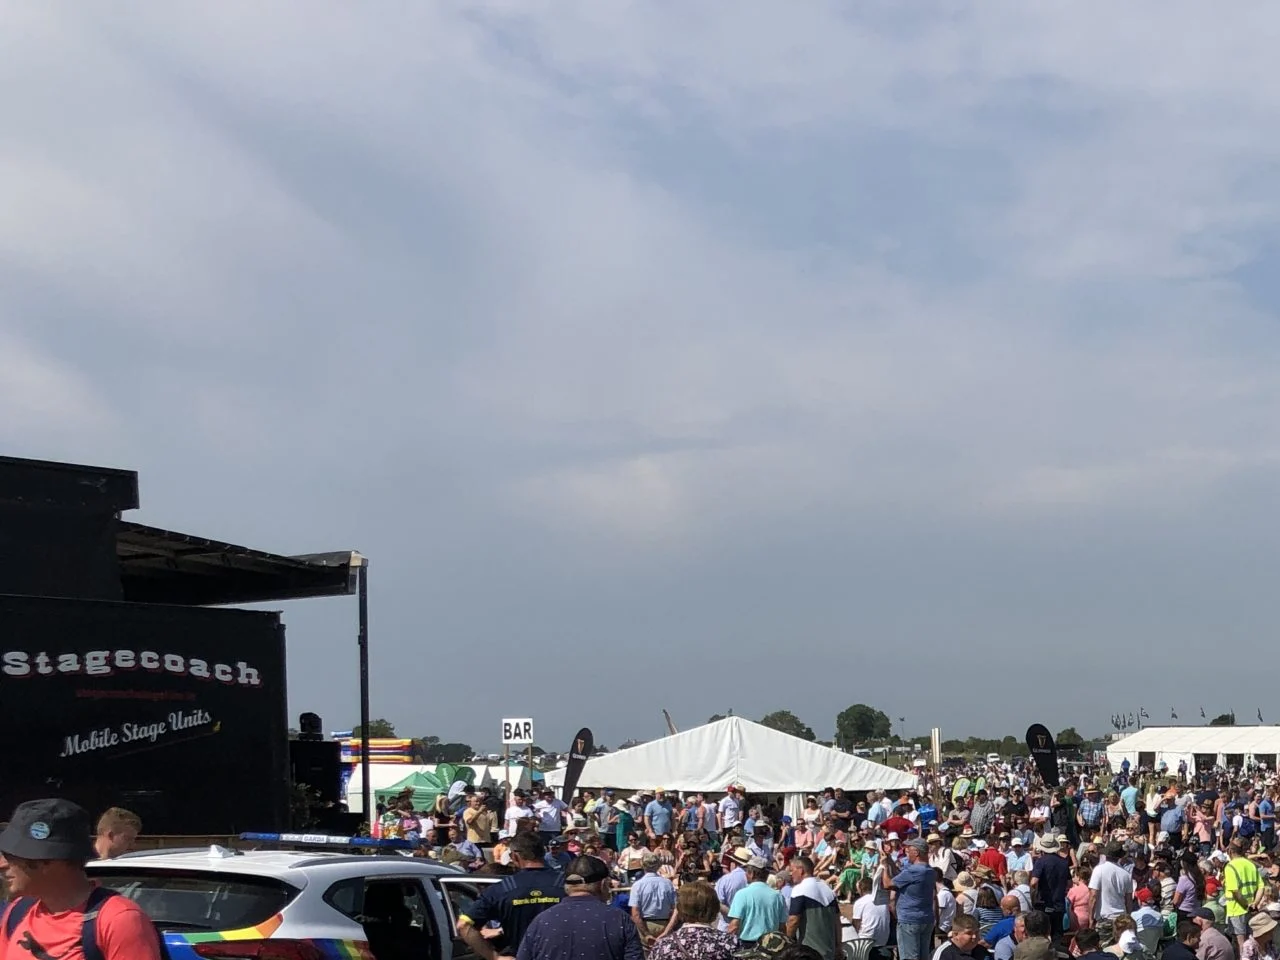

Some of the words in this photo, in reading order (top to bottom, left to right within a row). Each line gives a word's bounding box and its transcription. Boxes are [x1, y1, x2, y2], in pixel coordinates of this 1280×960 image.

[2, 649, 262, 686] Stagecoach
[59, 727, 120, 758] Mobile
[122, 721, 167, 744] Stage
[168, 708, 213, 732] Units
[503, 721, 533, 740] BAR
